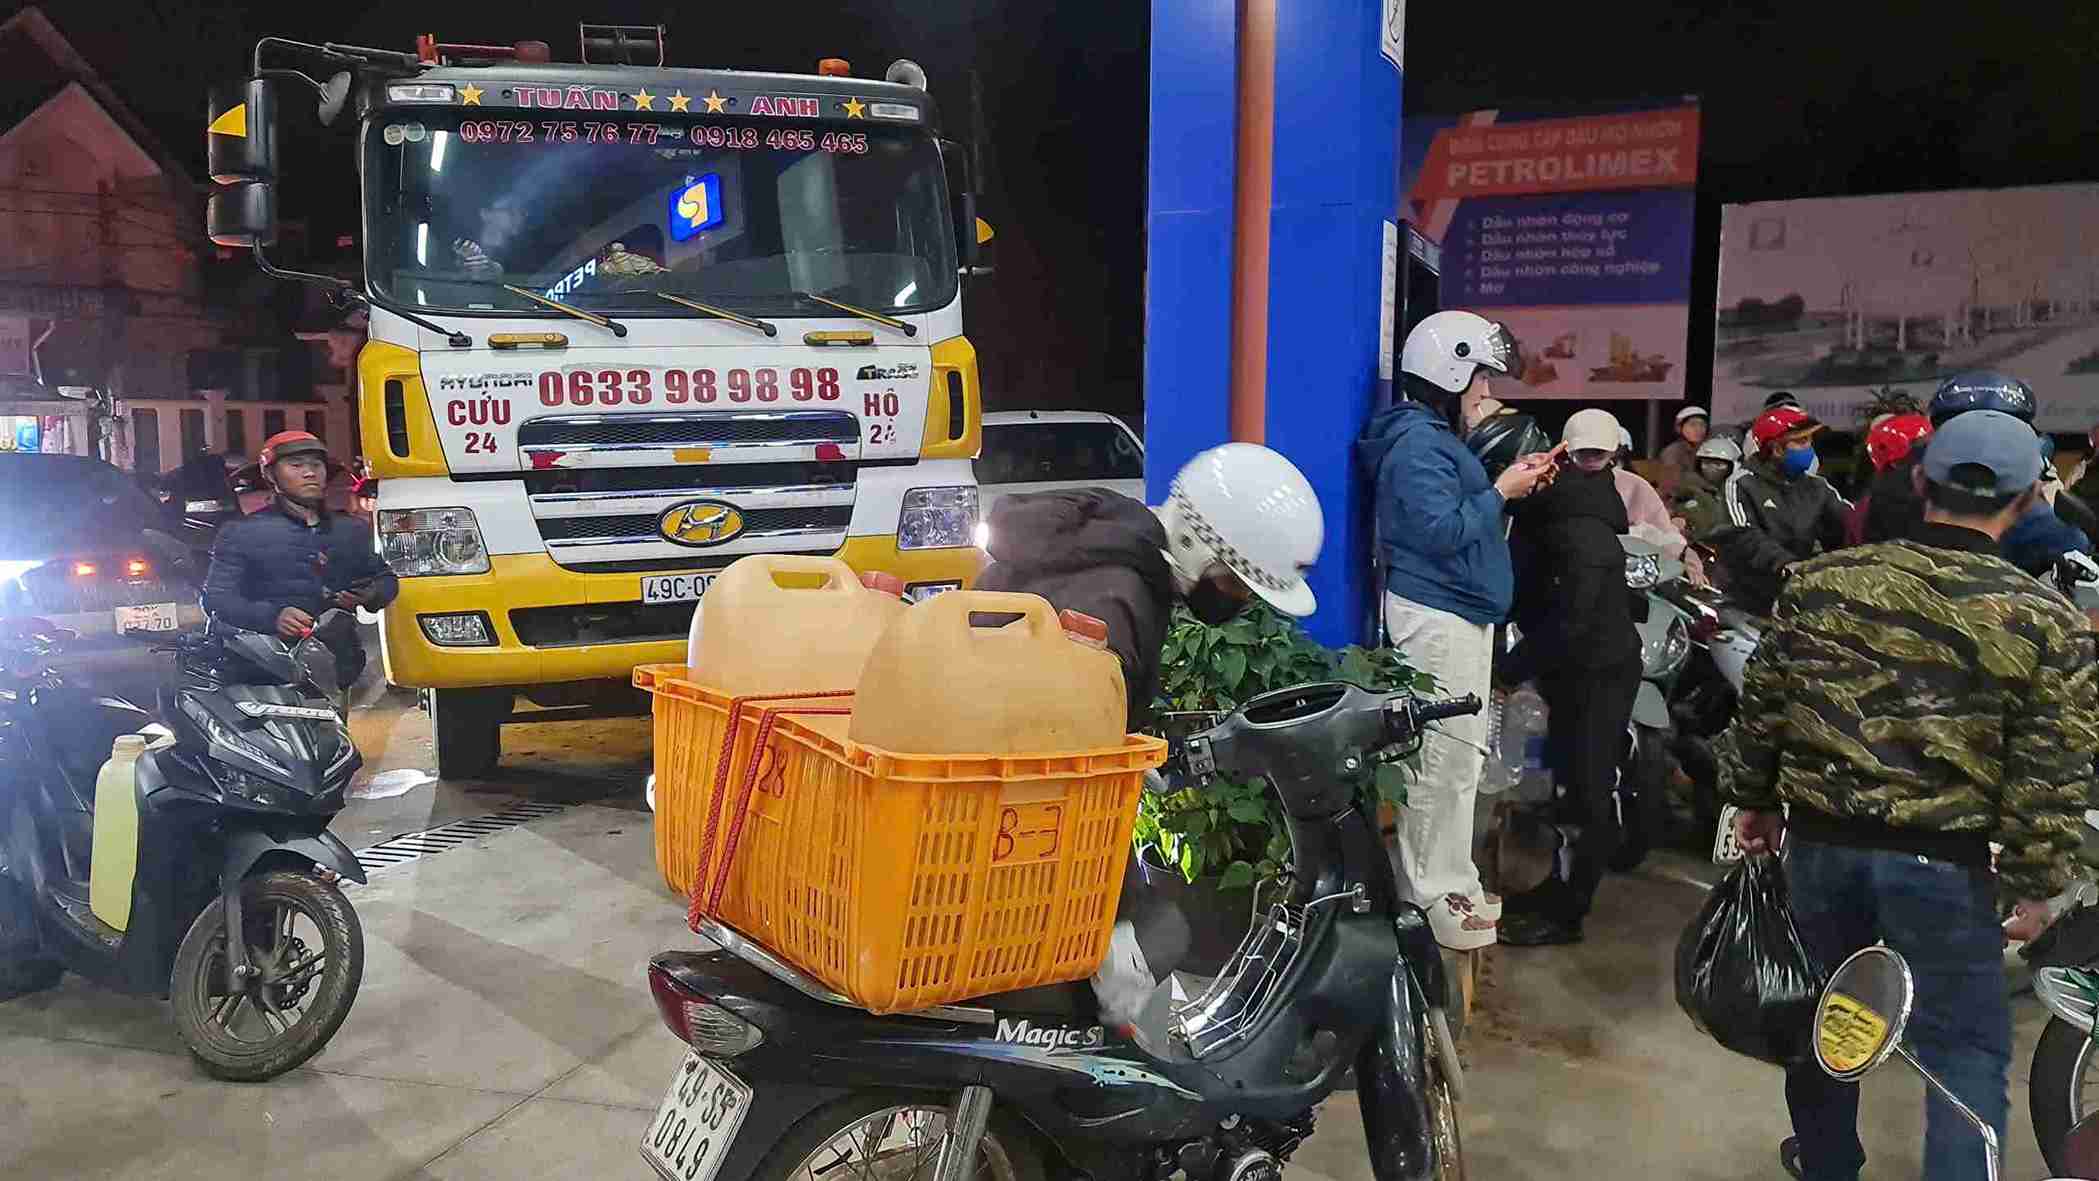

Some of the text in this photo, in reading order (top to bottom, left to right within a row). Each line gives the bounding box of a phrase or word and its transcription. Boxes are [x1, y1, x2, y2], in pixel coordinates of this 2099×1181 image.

[513, 84, 820, 118] TUẤN ANH
[460, 120, 534, 143] 0972
[541, 121, 578, 144] 75
[583, 122, 620, 144] 76
[627, 123, 661, 145] 77
[690, 126, 759, 149] 0918
[766, 129, 815, 151] 465
[821, 132, 868, 154] 465
[1447, 147, 1680, 188] PETROLIMEX
[538, 367, 841, 407] 0633 98 98 98
[447, 390, 511, 426] CỨU
[464, 432, 497, 454] 24
[994, 1018, 1081, 1053] Magic
[654, 1108, 710, 1181] 0849
